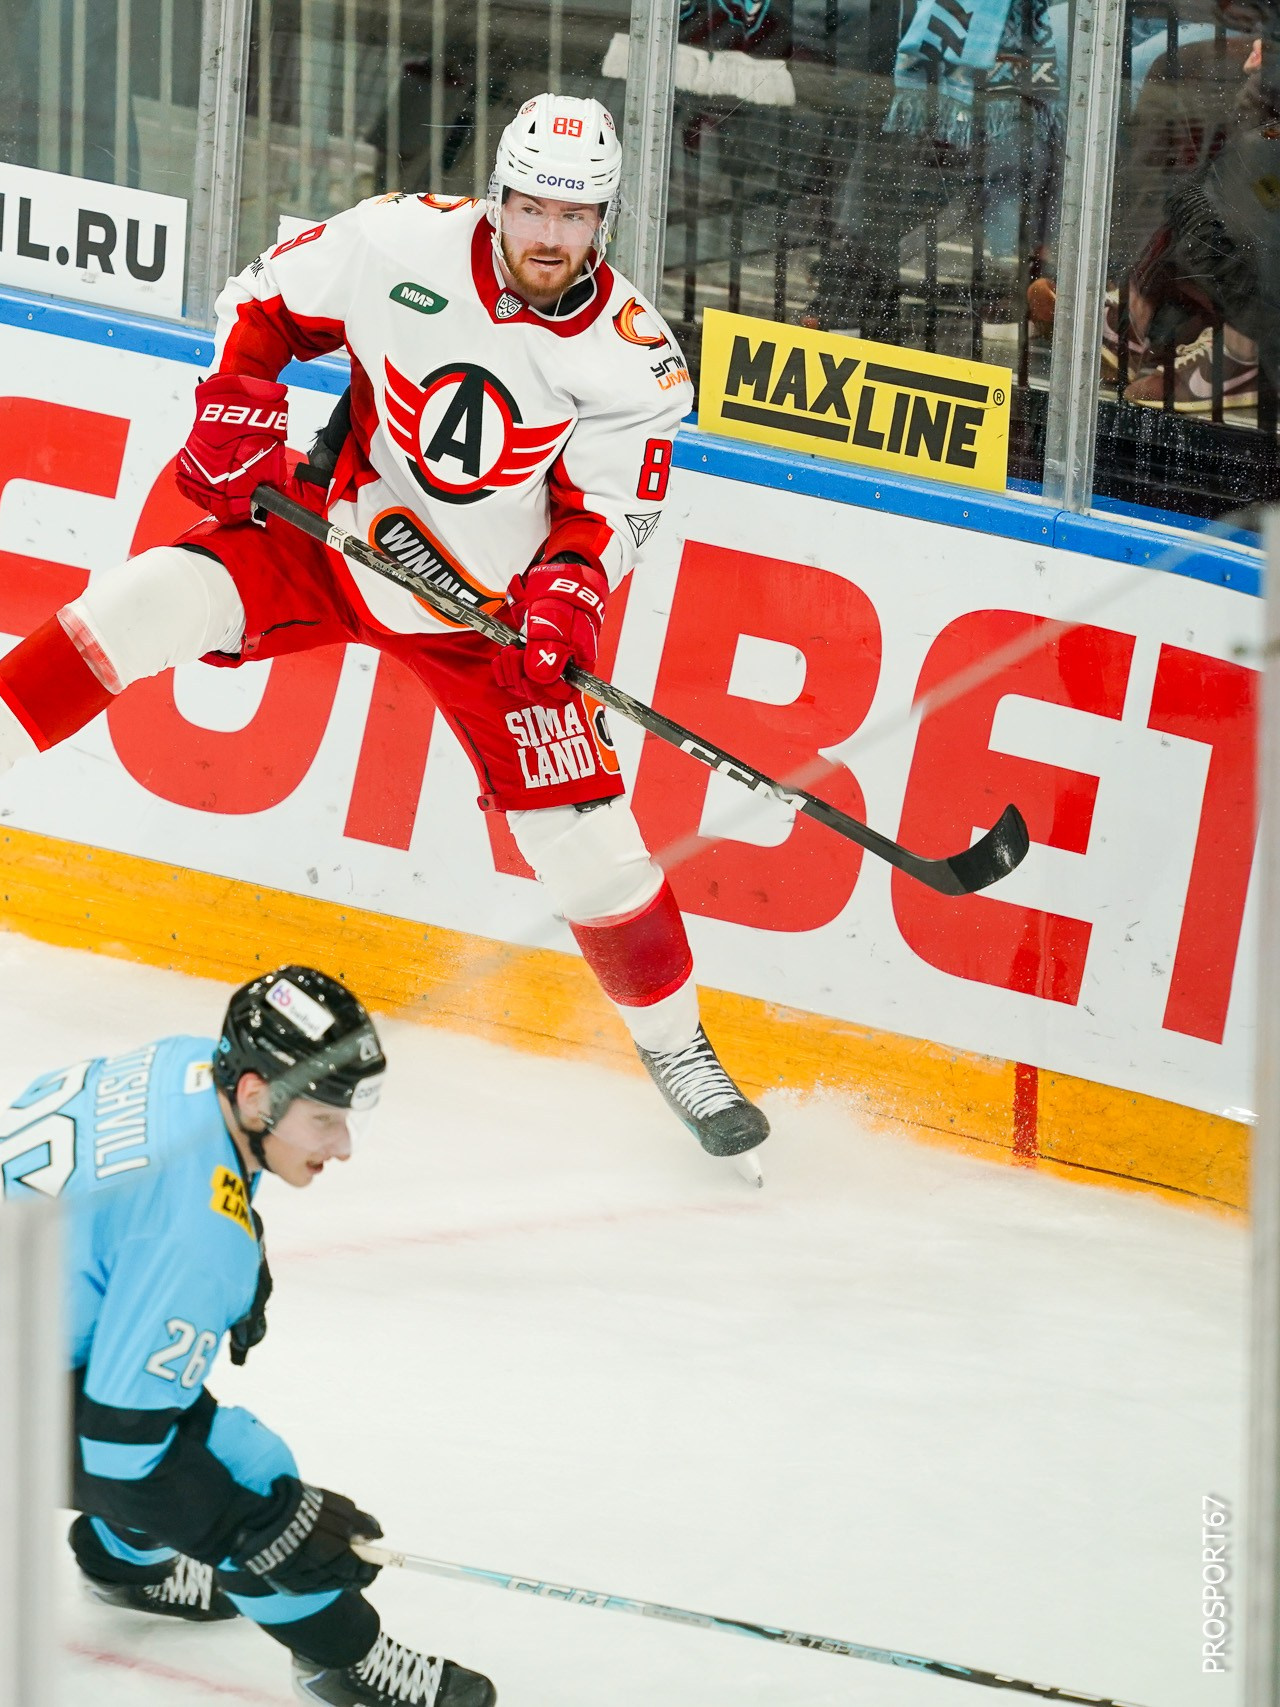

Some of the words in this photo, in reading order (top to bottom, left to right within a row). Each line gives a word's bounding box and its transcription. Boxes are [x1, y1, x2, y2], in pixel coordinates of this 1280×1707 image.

[553, 117, 583, 138] 89
[536, 173, 585, 191] согаз
[400, 286, 435, 308] МИР
[650, 355, 687, 379] УГМ
[200, 403, 288, 431] BAUE
[445, 603, 512, 647] JETS
[505, 702, 585, 748] SIMA
[517, 735, 596, 789] LAND
[679, 738, 808, 812] CCM
[144, 1317, 218, 1390] 26
